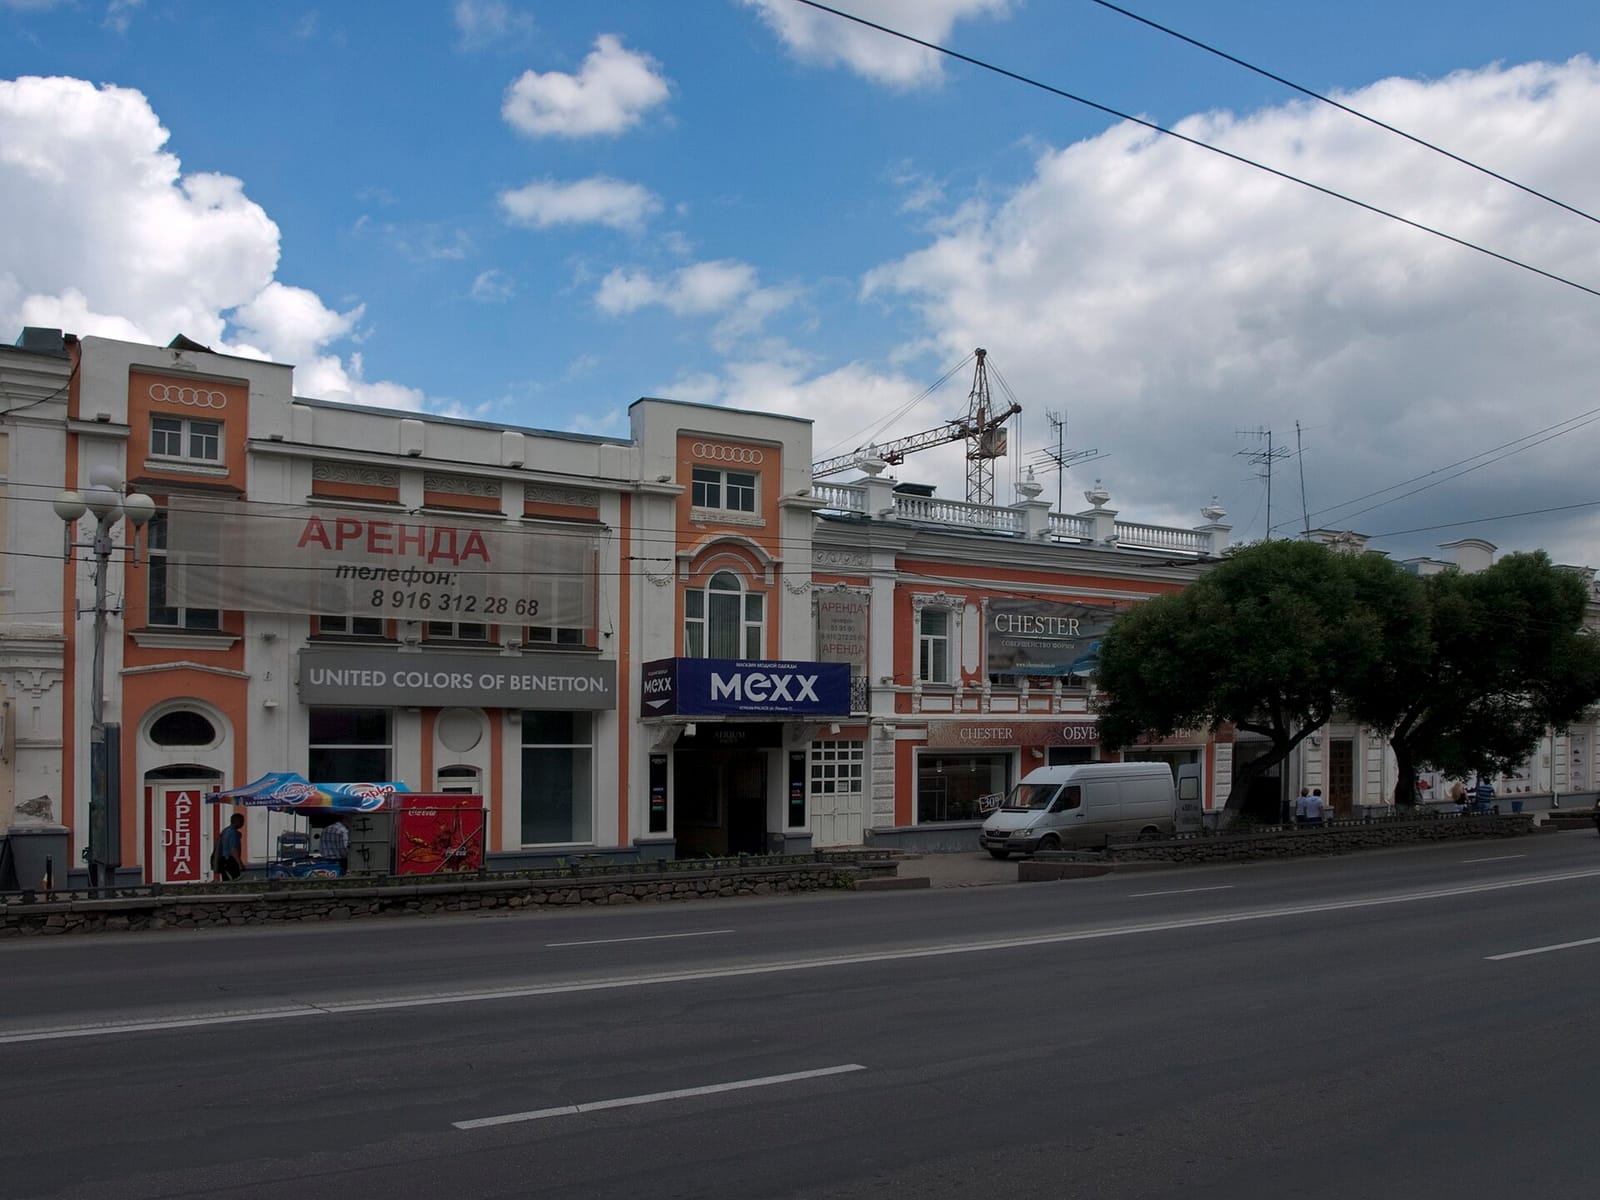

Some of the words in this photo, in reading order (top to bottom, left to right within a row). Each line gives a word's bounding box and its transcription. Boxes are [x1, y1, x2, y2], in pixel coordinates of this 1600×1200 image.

[297, 515, 491, 566] АРЕНДА
[335, 564, 458, 587] телефон:
[371, 589, 384, 607] 8
[391, 590, 431, 610] 916
[438, 593, 476, 612] 312
[483, 596, 508, 615] 28
[515, 598, 539, 616] 68
[821, 601, 865, 614] АРЕНДА
[994, 613, 1081, 636] CHESTER
[822, 643, 865, 656] АРЕНДА
[309, 668, 387, 687] UNITED
[392, 671, 473, 689] COLORS
[478, 674, 506, 690] OF
[509, 675, 609, 692] BENETTON.
[960, 727, 1013, 739] CHESTER
[173, 791, 193, 875] АРЕНДА
